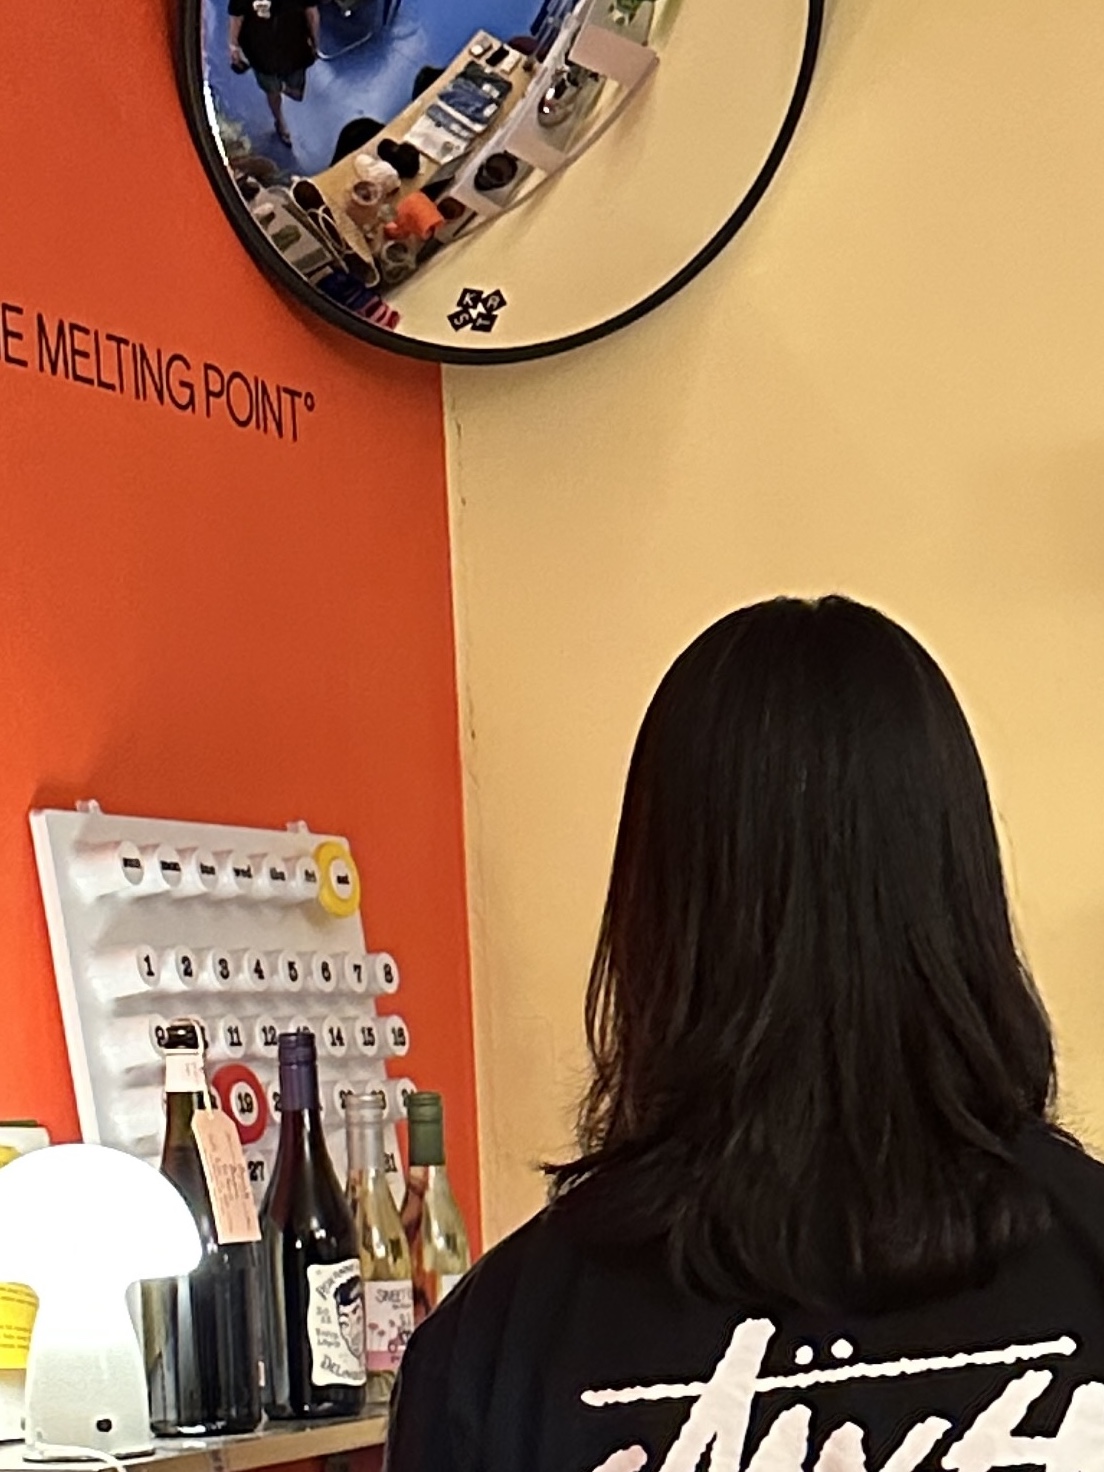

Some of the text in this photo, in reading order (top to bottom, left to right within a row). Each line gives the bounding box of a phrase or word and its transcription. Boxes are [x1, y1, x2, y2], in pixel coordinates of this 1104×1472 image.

[36, 312, 196, 414] MELTING
[143, 954, 394, 984] 1 2 3 4 5 6 7 8
[227, 1025, 243, 1047] 11
[261, 1025, 278, 1047] 12
[328, 1026, 345, 1047] 14
[361, 1026, 376, 1047] 15
[237, 1092, 254, 1113] 19
[247, 1155, 265, 1177] 27
